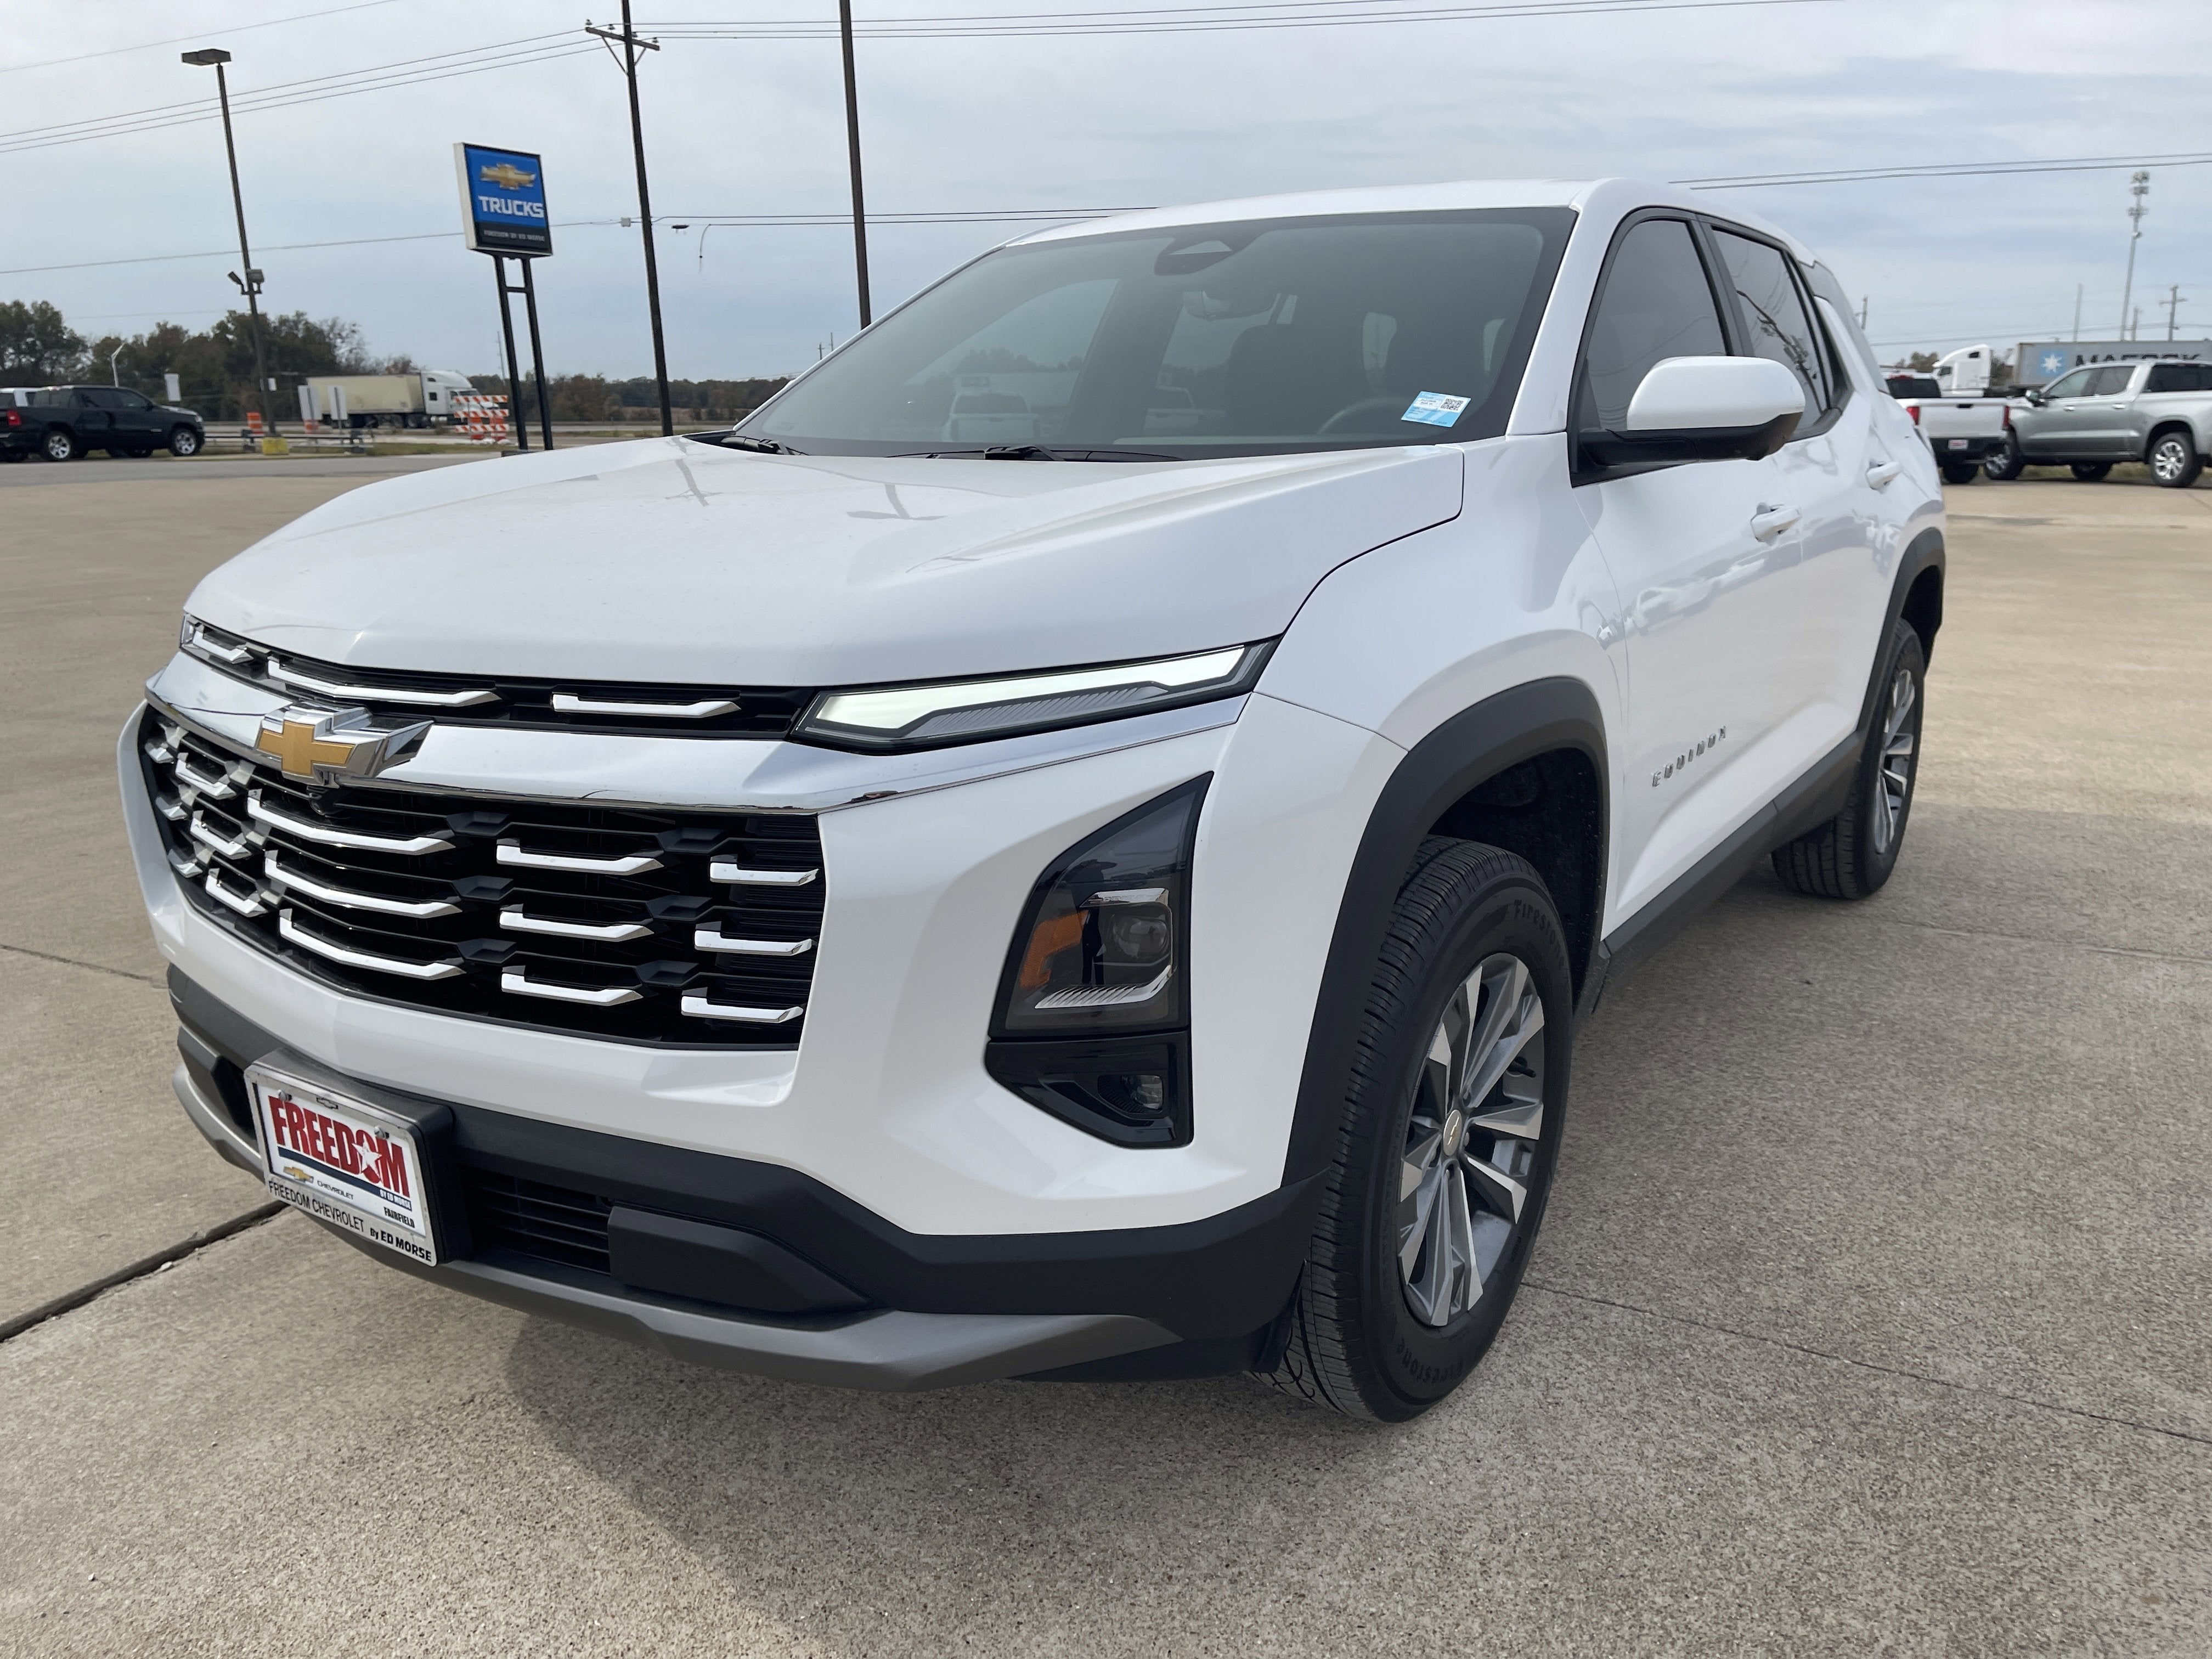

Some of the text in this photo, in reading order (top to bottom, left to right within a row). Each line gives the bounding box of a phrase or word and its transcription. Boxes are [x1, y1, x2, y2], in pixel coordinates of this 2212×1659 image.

[478, 195, 545, 218] TRUCKS
[1652, 726, 1726, 787] EQUINOX
[268, 1096, 410, 1198] FREEDOM
[317, 1180, 354, 1200] CHEVROLET
[269, 1181, 311, 1209] FREEDOM
[312, 1199, 364, 1232] CHEVROLET
[381, 1230, 393, 1244] ED
[396, 1237, 432, 1262] MORSE
[383, 1206, 415, 1228] FAIRFIELD
